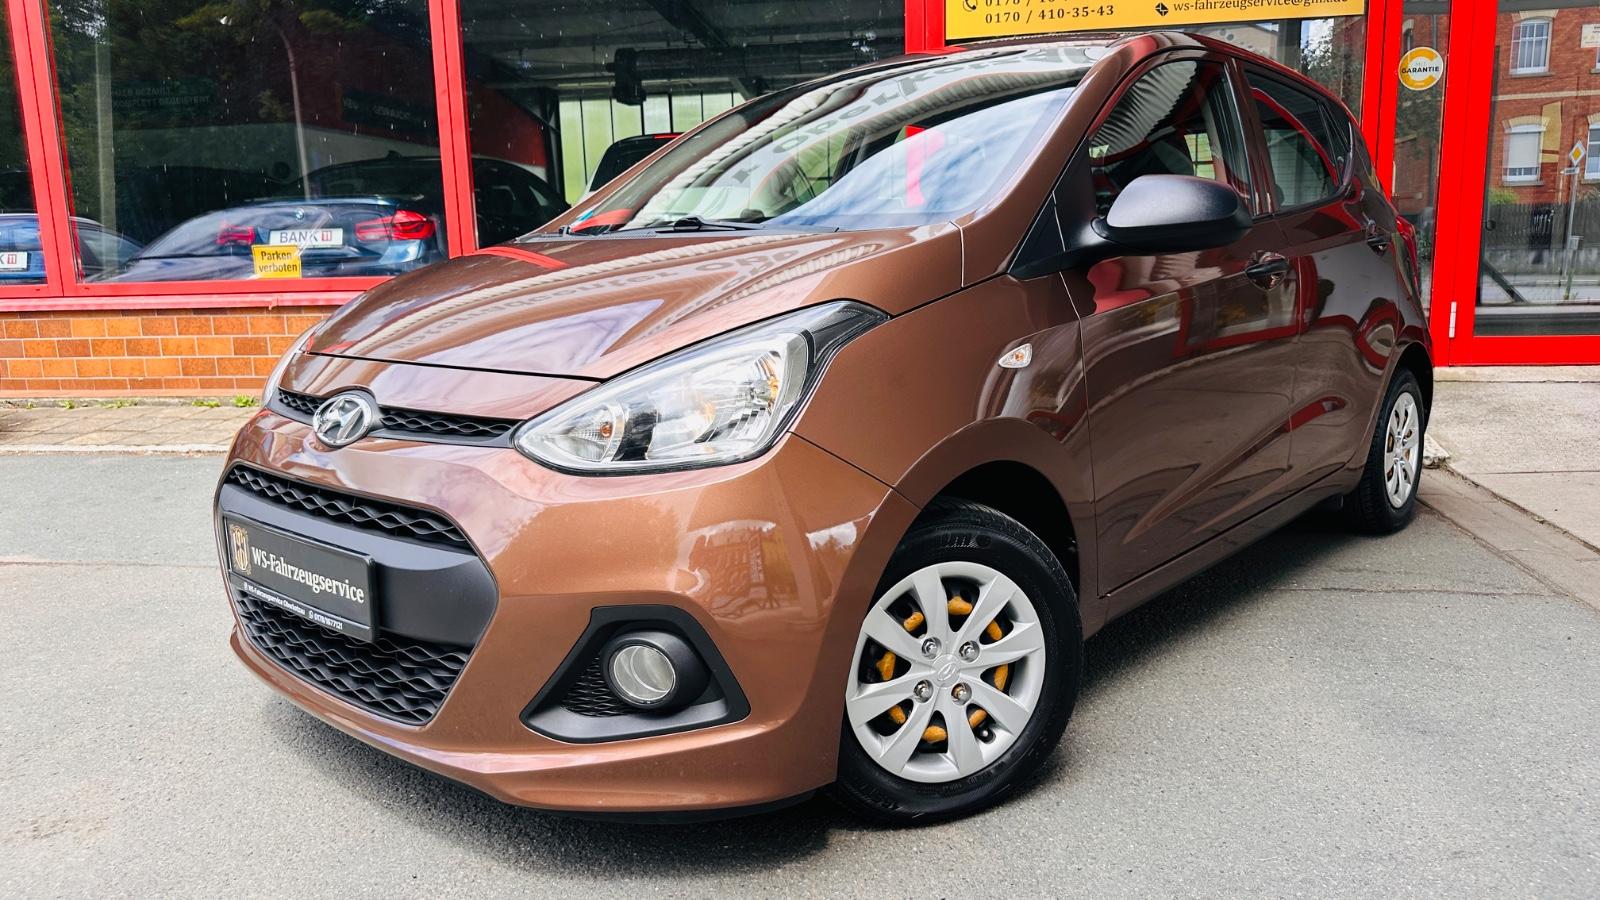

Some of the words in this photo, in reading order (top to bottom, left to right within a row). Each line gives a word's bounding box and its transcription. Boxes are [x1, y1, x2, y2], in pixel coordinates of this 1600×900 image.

[985, 12, 1020, 23] 0170
[1026, 10, 1032, 24] /
[1038, 5, 1114, 20] 410-35-43
[1401, 66, 1440, 74] GARANTIE
[260, 250, 293, 261] Parken
[258, 263, 298, 274] verboten
[251, 547, 365, 604] WS-Fahrzeugservice
